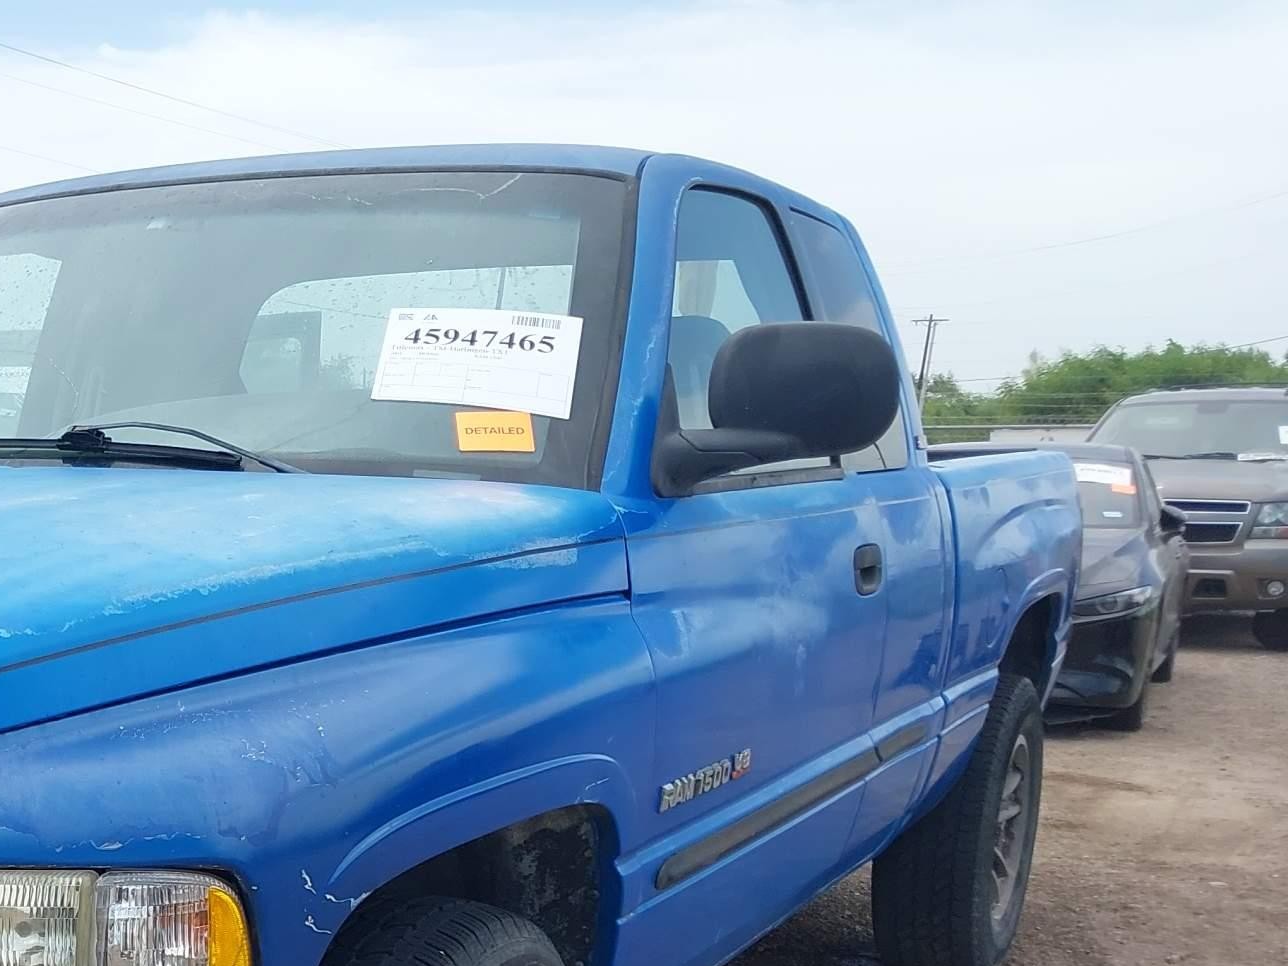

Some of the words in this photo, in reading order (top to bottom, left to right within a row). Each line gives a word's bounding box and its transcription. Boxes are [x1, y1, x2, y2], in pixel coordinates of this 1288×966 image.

[404, 327, 556, 354] 45947465
[464, 426, 525, 435] DETAILED
[660, 773, 694, 813] RAM
[695, 758, 731, 795] 1500
